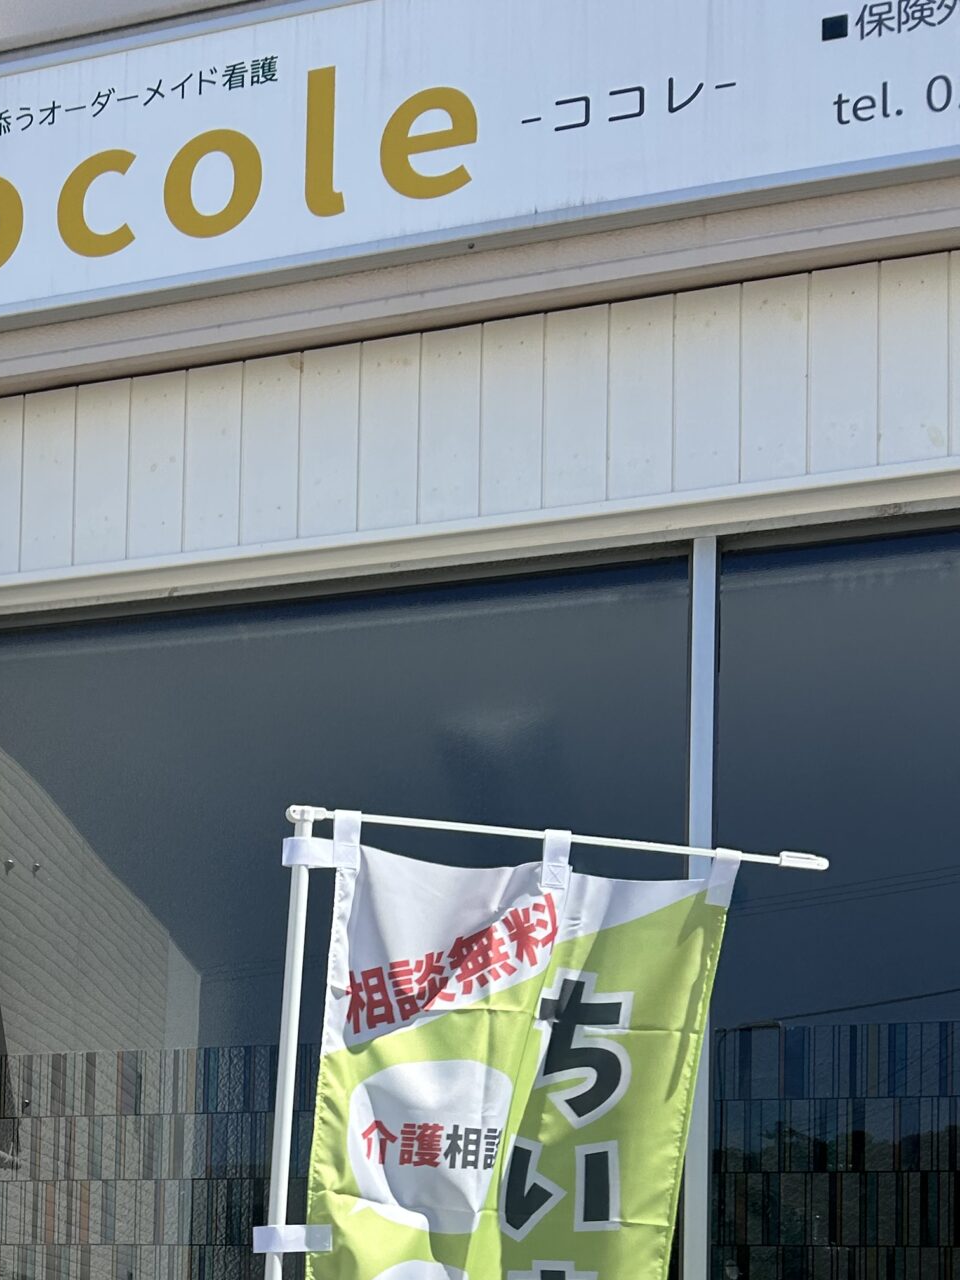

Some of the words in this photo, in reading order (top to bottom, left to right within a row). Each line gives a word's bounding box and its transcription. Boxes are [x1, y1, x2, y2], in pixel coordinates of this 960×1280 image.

[833, 81, 903, 125] tel.
[346, 892, 559, 1034] 相談無料
